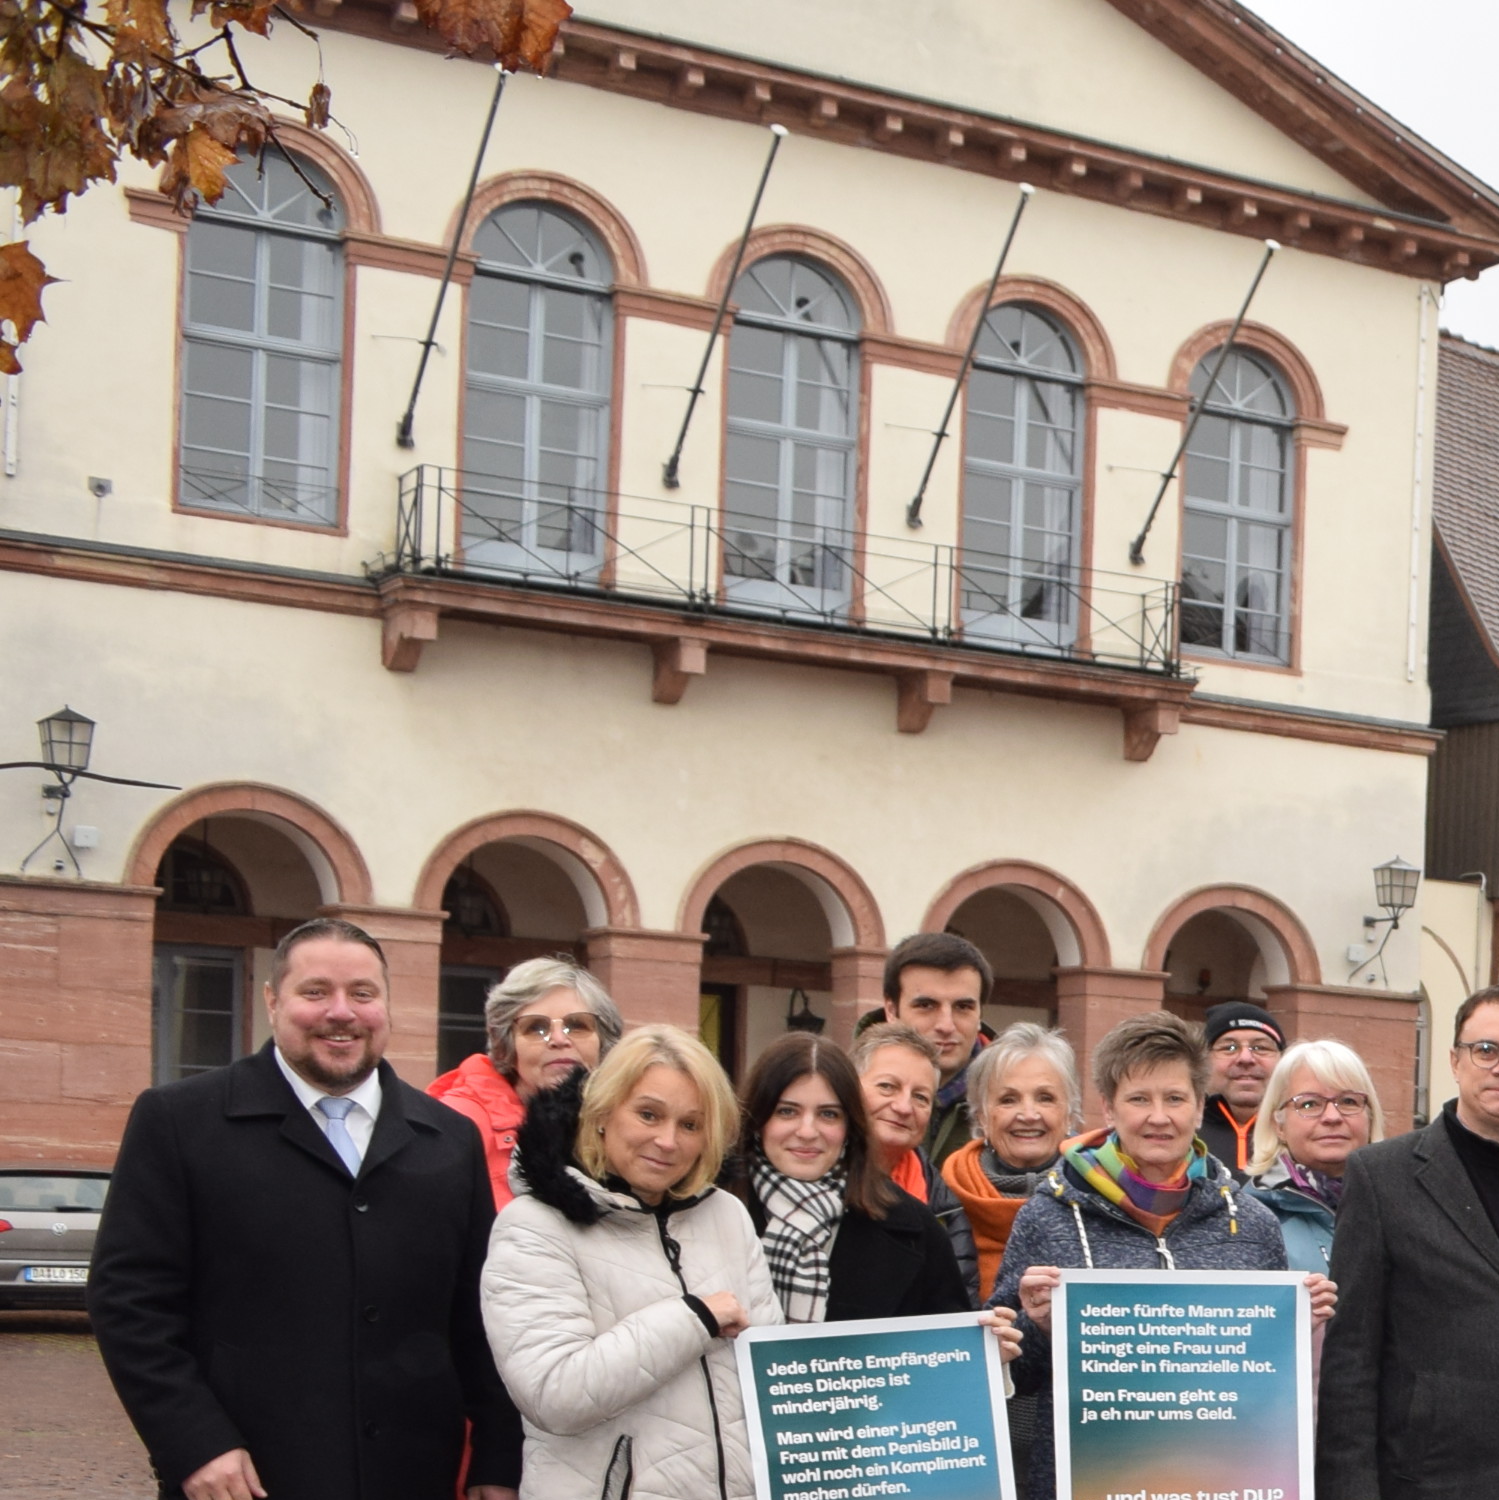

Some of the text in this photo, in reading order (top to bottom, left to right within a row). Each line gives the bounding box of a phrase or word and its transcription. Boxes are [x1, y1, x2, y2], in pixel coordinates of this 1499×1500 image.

[1080, 1304, 1276, 1318] Jeder fünfte Mann zahlt
[1081, 1322, 1251, 1336] keinen Unterhalt und
[1081, 1341, 1246, 1357] bringt eine Frau und
[767, 1350, 970, 1376] Jede fünfte Empfängerin
[1082, 1360, 1276, 1372] Kinder in finanzielle Not.
[770, 1374, 910, 1395] eines Dickpics ist
[772, 1395, 882, 1414] minderjährig.
